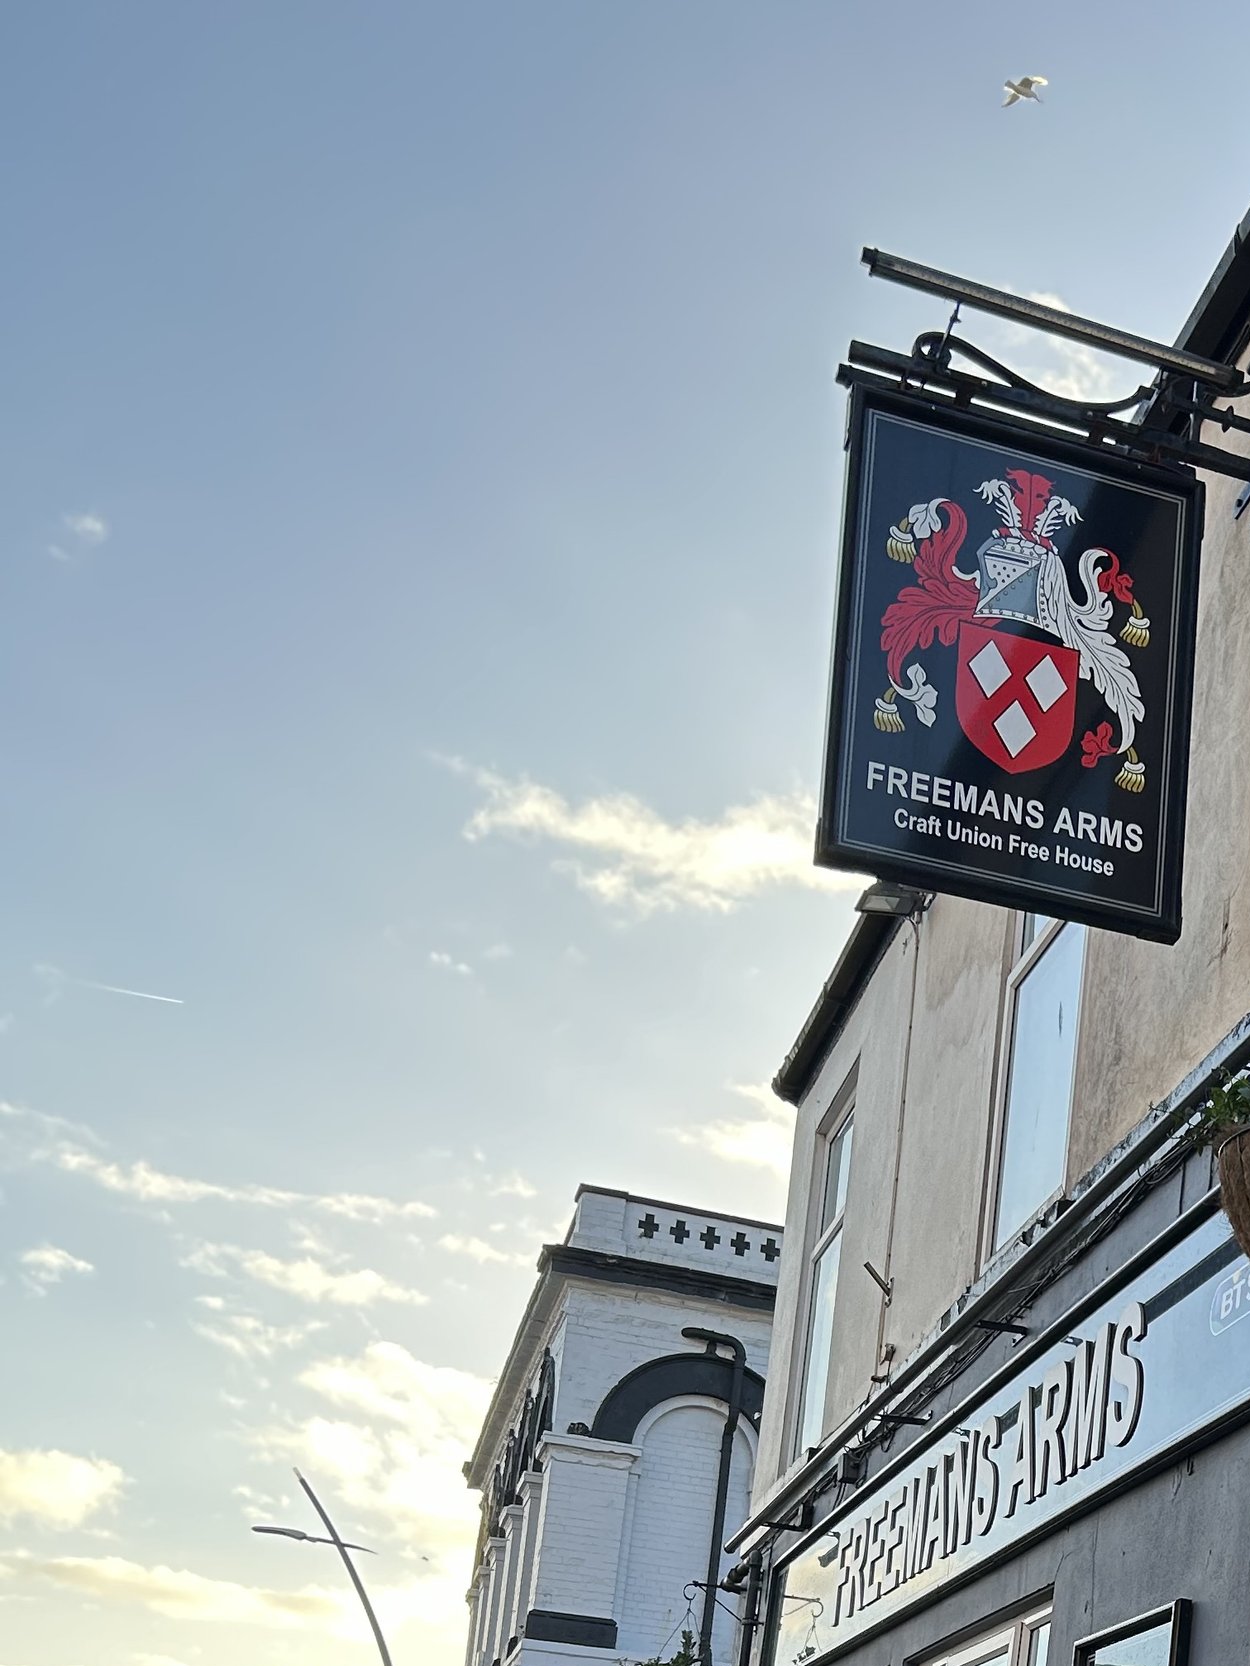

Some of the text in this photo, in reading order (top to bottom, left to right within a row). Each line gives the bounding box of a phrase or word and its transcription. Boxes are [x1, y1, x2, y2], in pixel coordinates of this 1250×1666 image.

[867, 762, 1143, 852] FREEMANS ARMS
[894, 807, 1114, 876] Craft Union Free House
[1220, 1278, 1245, 1320] BT
[832, 1302, 1148, 1627] FREEMANS ARMS
